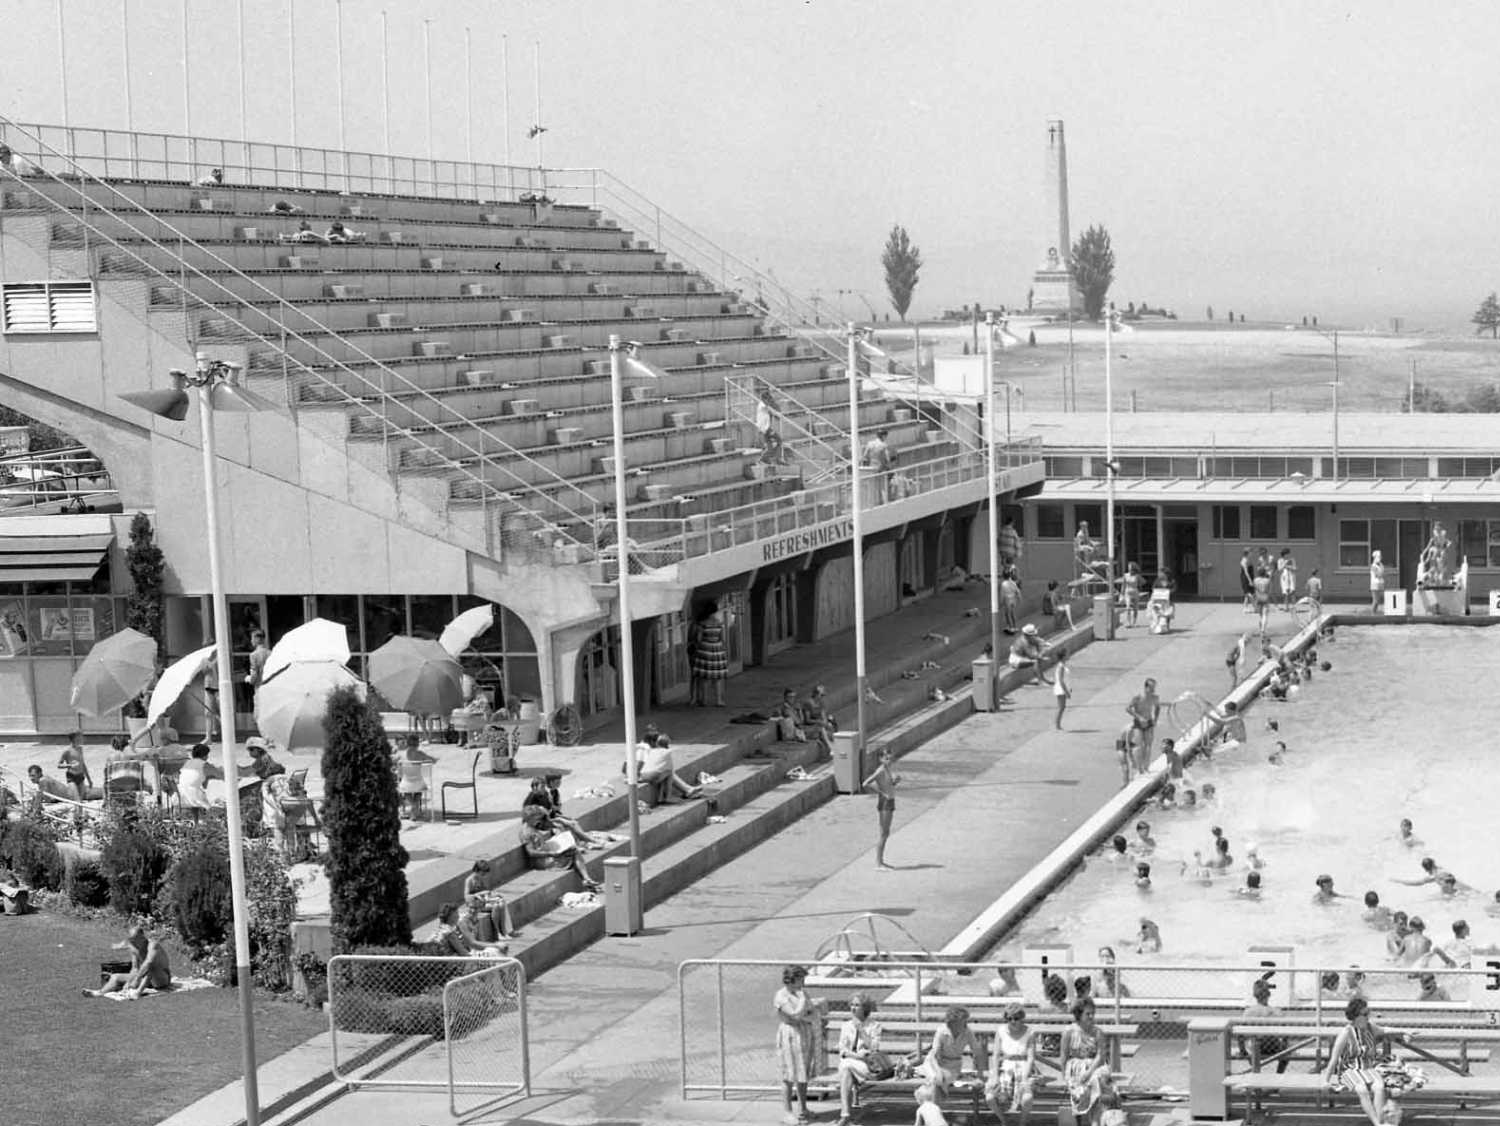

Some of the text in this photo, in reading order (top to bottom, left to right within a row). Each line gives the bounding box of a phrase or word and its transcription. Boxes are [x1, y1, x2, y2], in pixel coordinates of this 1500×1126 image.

[763, 521, 854, 561] REFRESHMENTS
[1392, 594, 1397, 609] 1
[1486, 961, 1500, 990] 3
